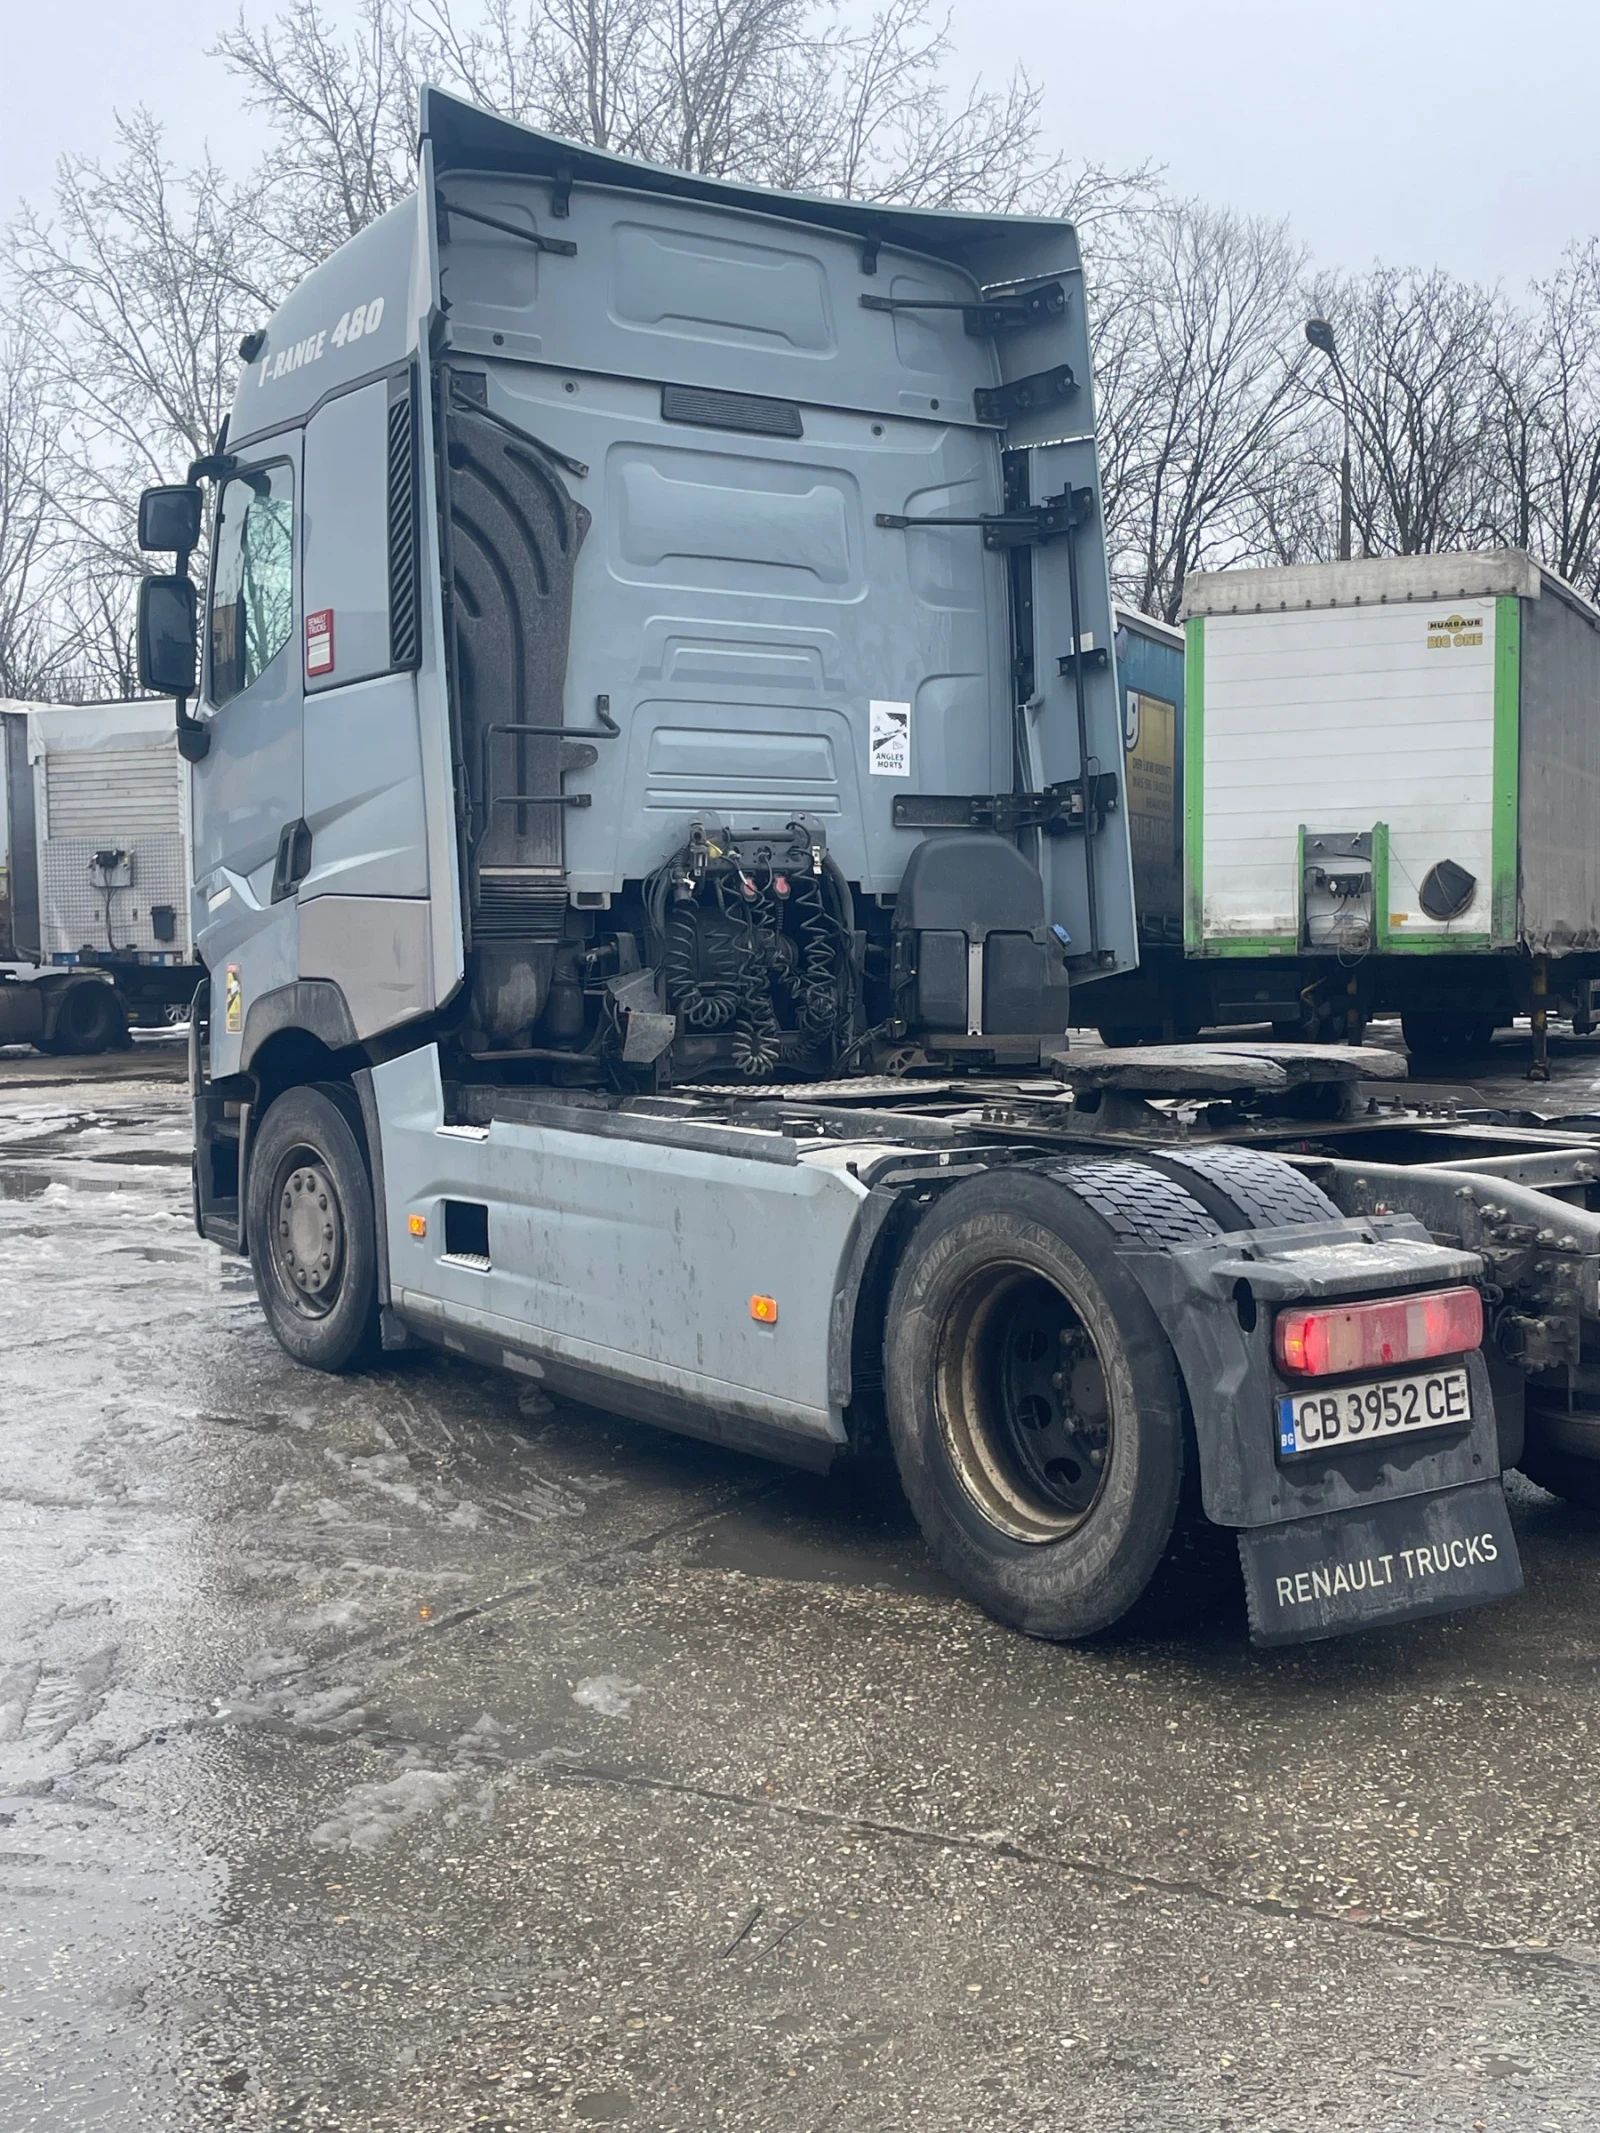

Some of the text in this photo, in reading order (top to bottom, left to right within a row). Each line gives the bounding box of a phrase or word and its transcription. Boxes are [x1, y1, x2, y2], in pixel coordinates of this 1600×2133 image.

[258, 296, 385, 388] T-RANGE 480
[1430, 619, 1481, 629] HUMBAUR
[1427, 632, 1483, 649] BIG ONE
[876, 752, 904, 761] ANGLES
[877, 761, 903, 769] MORTS
[1300, 1375, 1465, 1443] CB 3952 CE
[1281, 1432, 1295, 1447] BG
[1276, 1533, 1498, 1607] RENAULT TRUCKS
